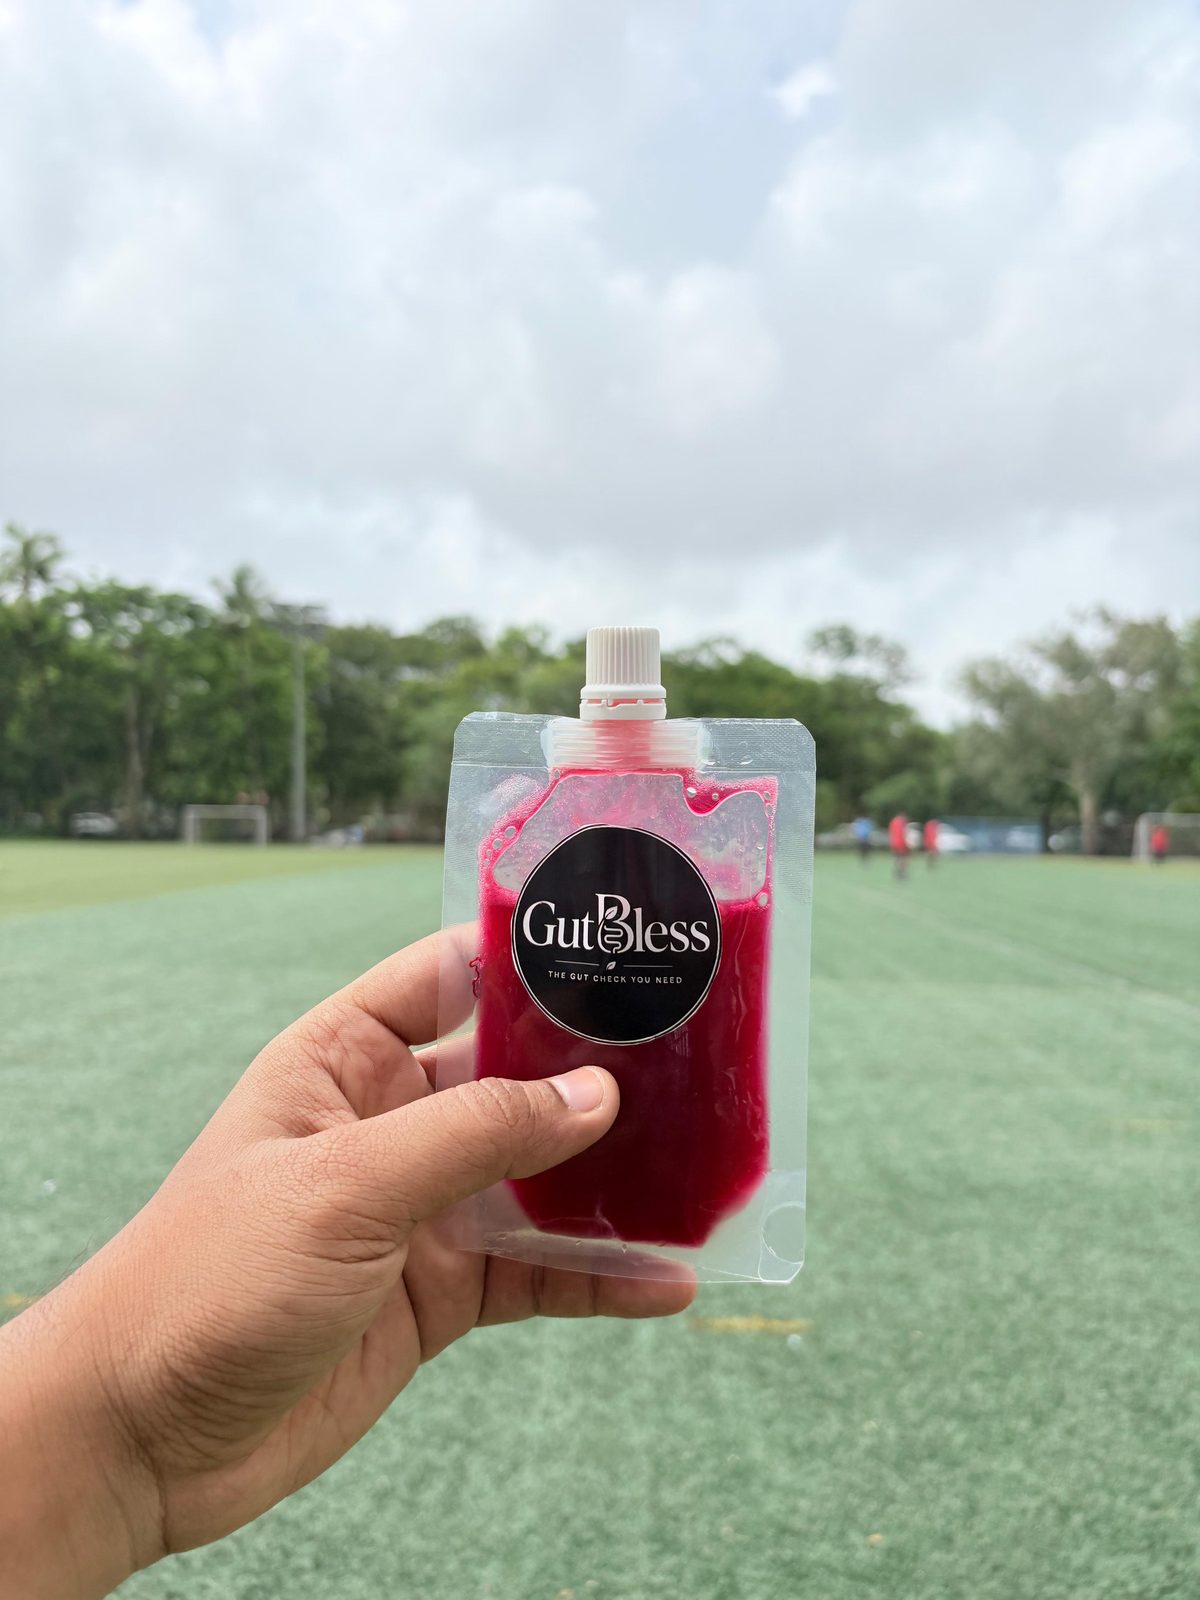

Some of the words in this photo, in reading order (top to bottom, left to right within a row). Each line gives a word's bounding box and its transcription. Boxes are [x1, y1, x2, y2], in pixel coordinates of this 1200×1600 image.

[522, 893, 711, 954] GutBless
[548, 970, 566, 979] THE
[570, 972, 589, 981] GUT
[593, 974, 627, 983] CHECK
[631, 976, 651, 984] YOU
[655, 976, 683, 984] NEED
